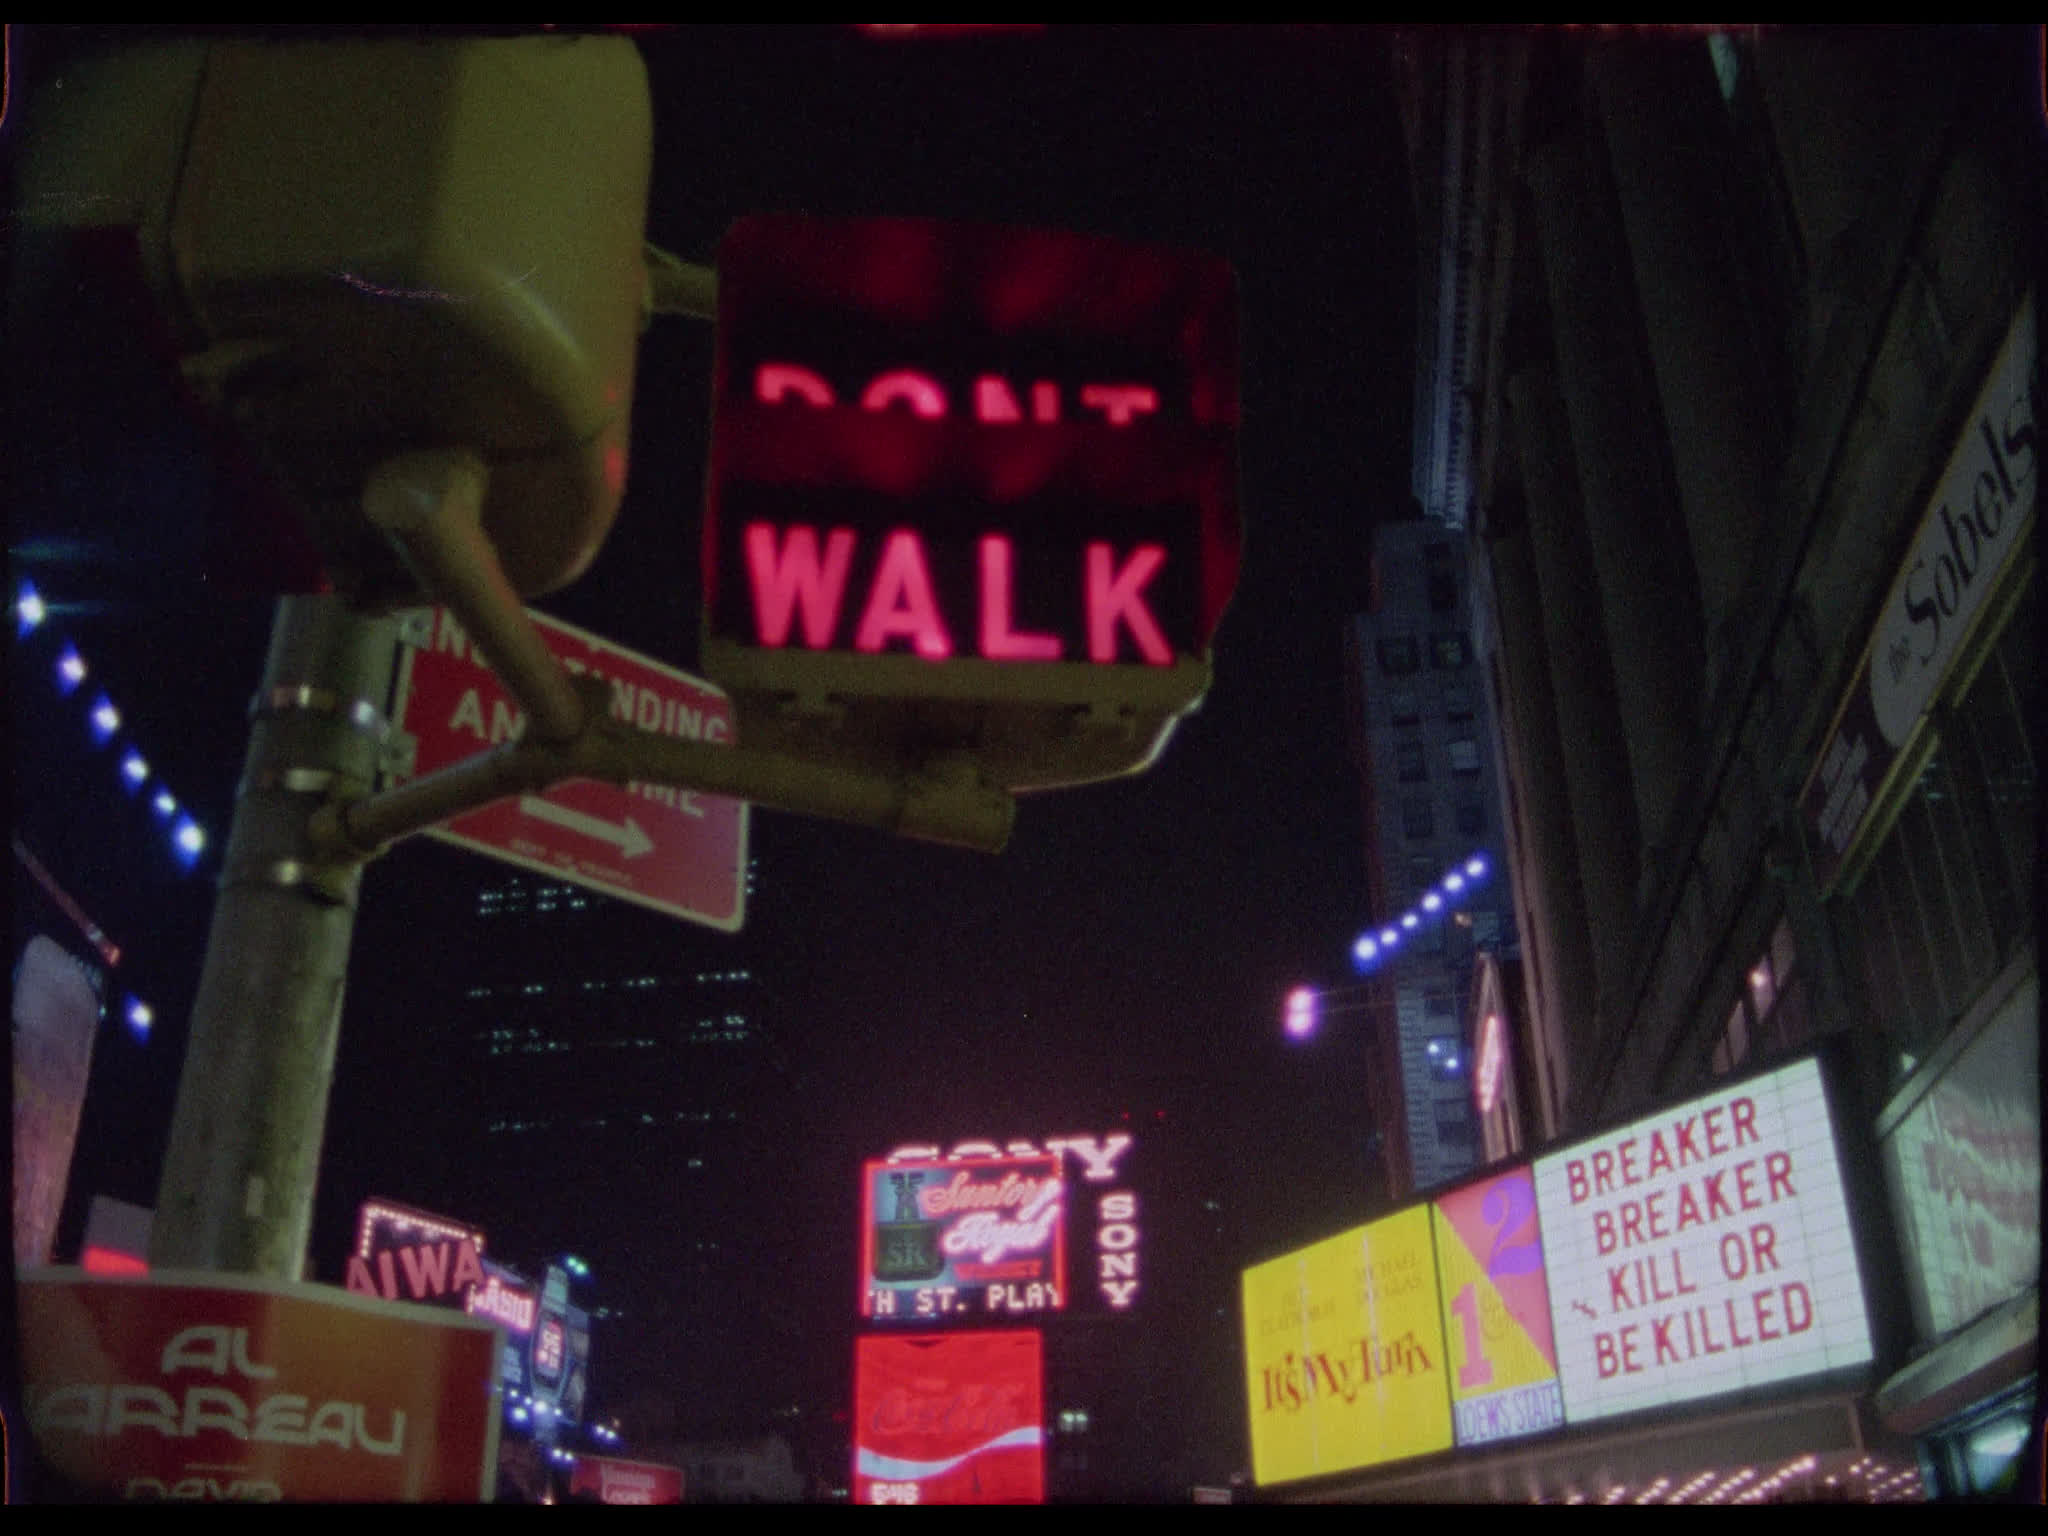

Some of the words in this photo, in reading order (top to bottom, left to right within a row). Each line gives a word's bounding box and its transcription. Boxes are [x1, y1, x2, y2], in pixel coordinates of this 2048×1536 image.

[744, 518, 1174, 668] WALK
[1565, 1097, 1760, 1205] BREAKER
[1593, 1151, 1797, 1256] BREAKER
[345, 1239, 484, 1299] AIWA
[1101, 1194, 1137, 1307] SONY
[1481, 1176, 1545, 1283] 2
[1607, 1250, 1697, 1313] KILL
[1720, 1222, 1781, 1281] OR
[161, 1325, 278, 1378] AL
[916, 1286, 967, 1313] ST.
[1451, 1281, 1495, 1390] 1
[1594, 1324, 1644, 1379] BE
[1652, 1281, 1814, 1366] KILLED
